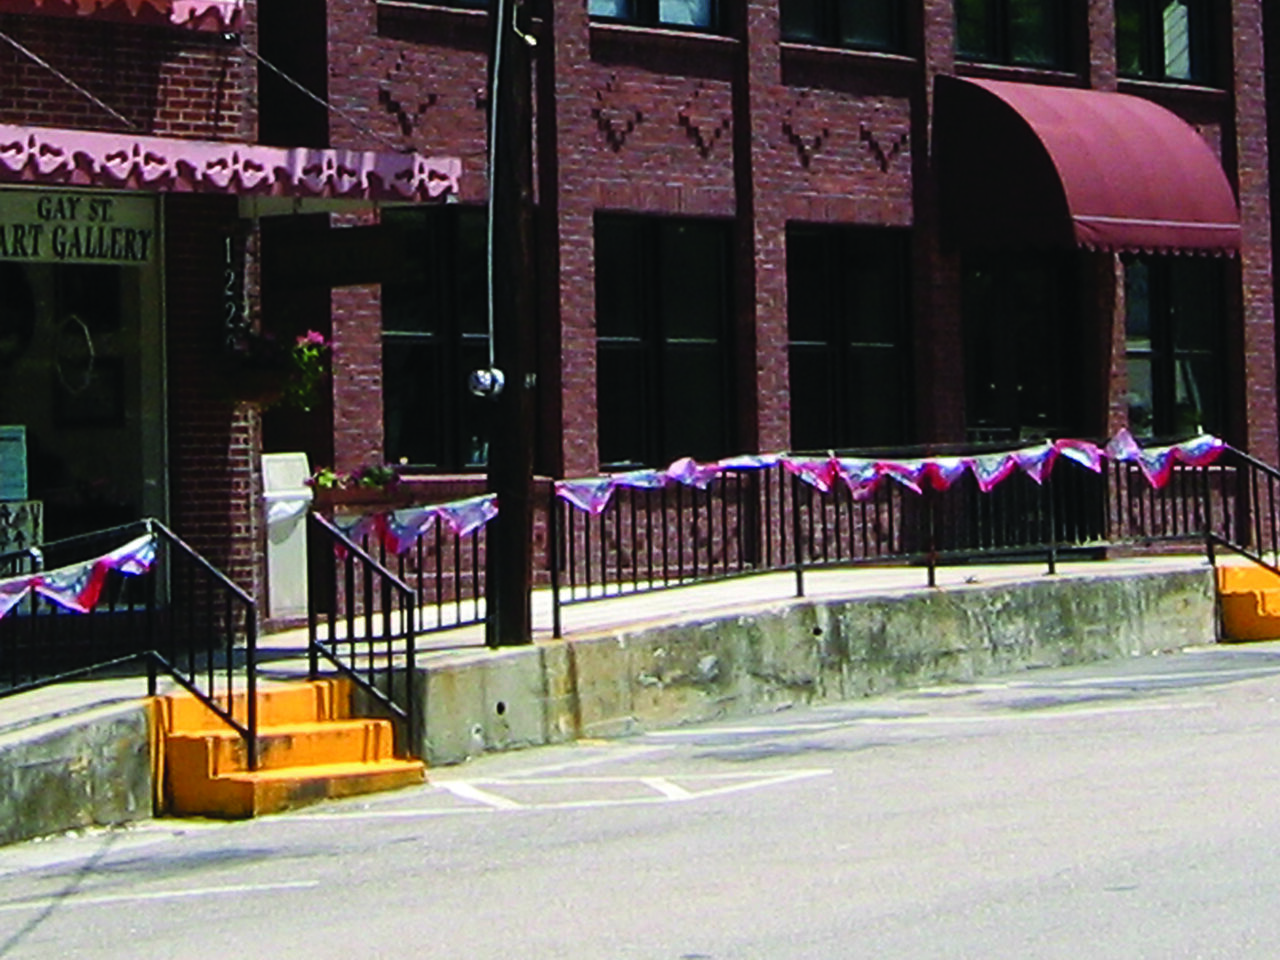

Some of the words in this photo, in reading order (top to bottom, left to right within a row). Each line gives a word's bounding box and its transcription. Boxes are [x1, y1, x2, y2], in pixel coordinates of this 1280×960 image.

[37, 196, 80, 221] GAY
[0, 224, 43, 257] ART
[52, 225, 152, 261] GALLERY
